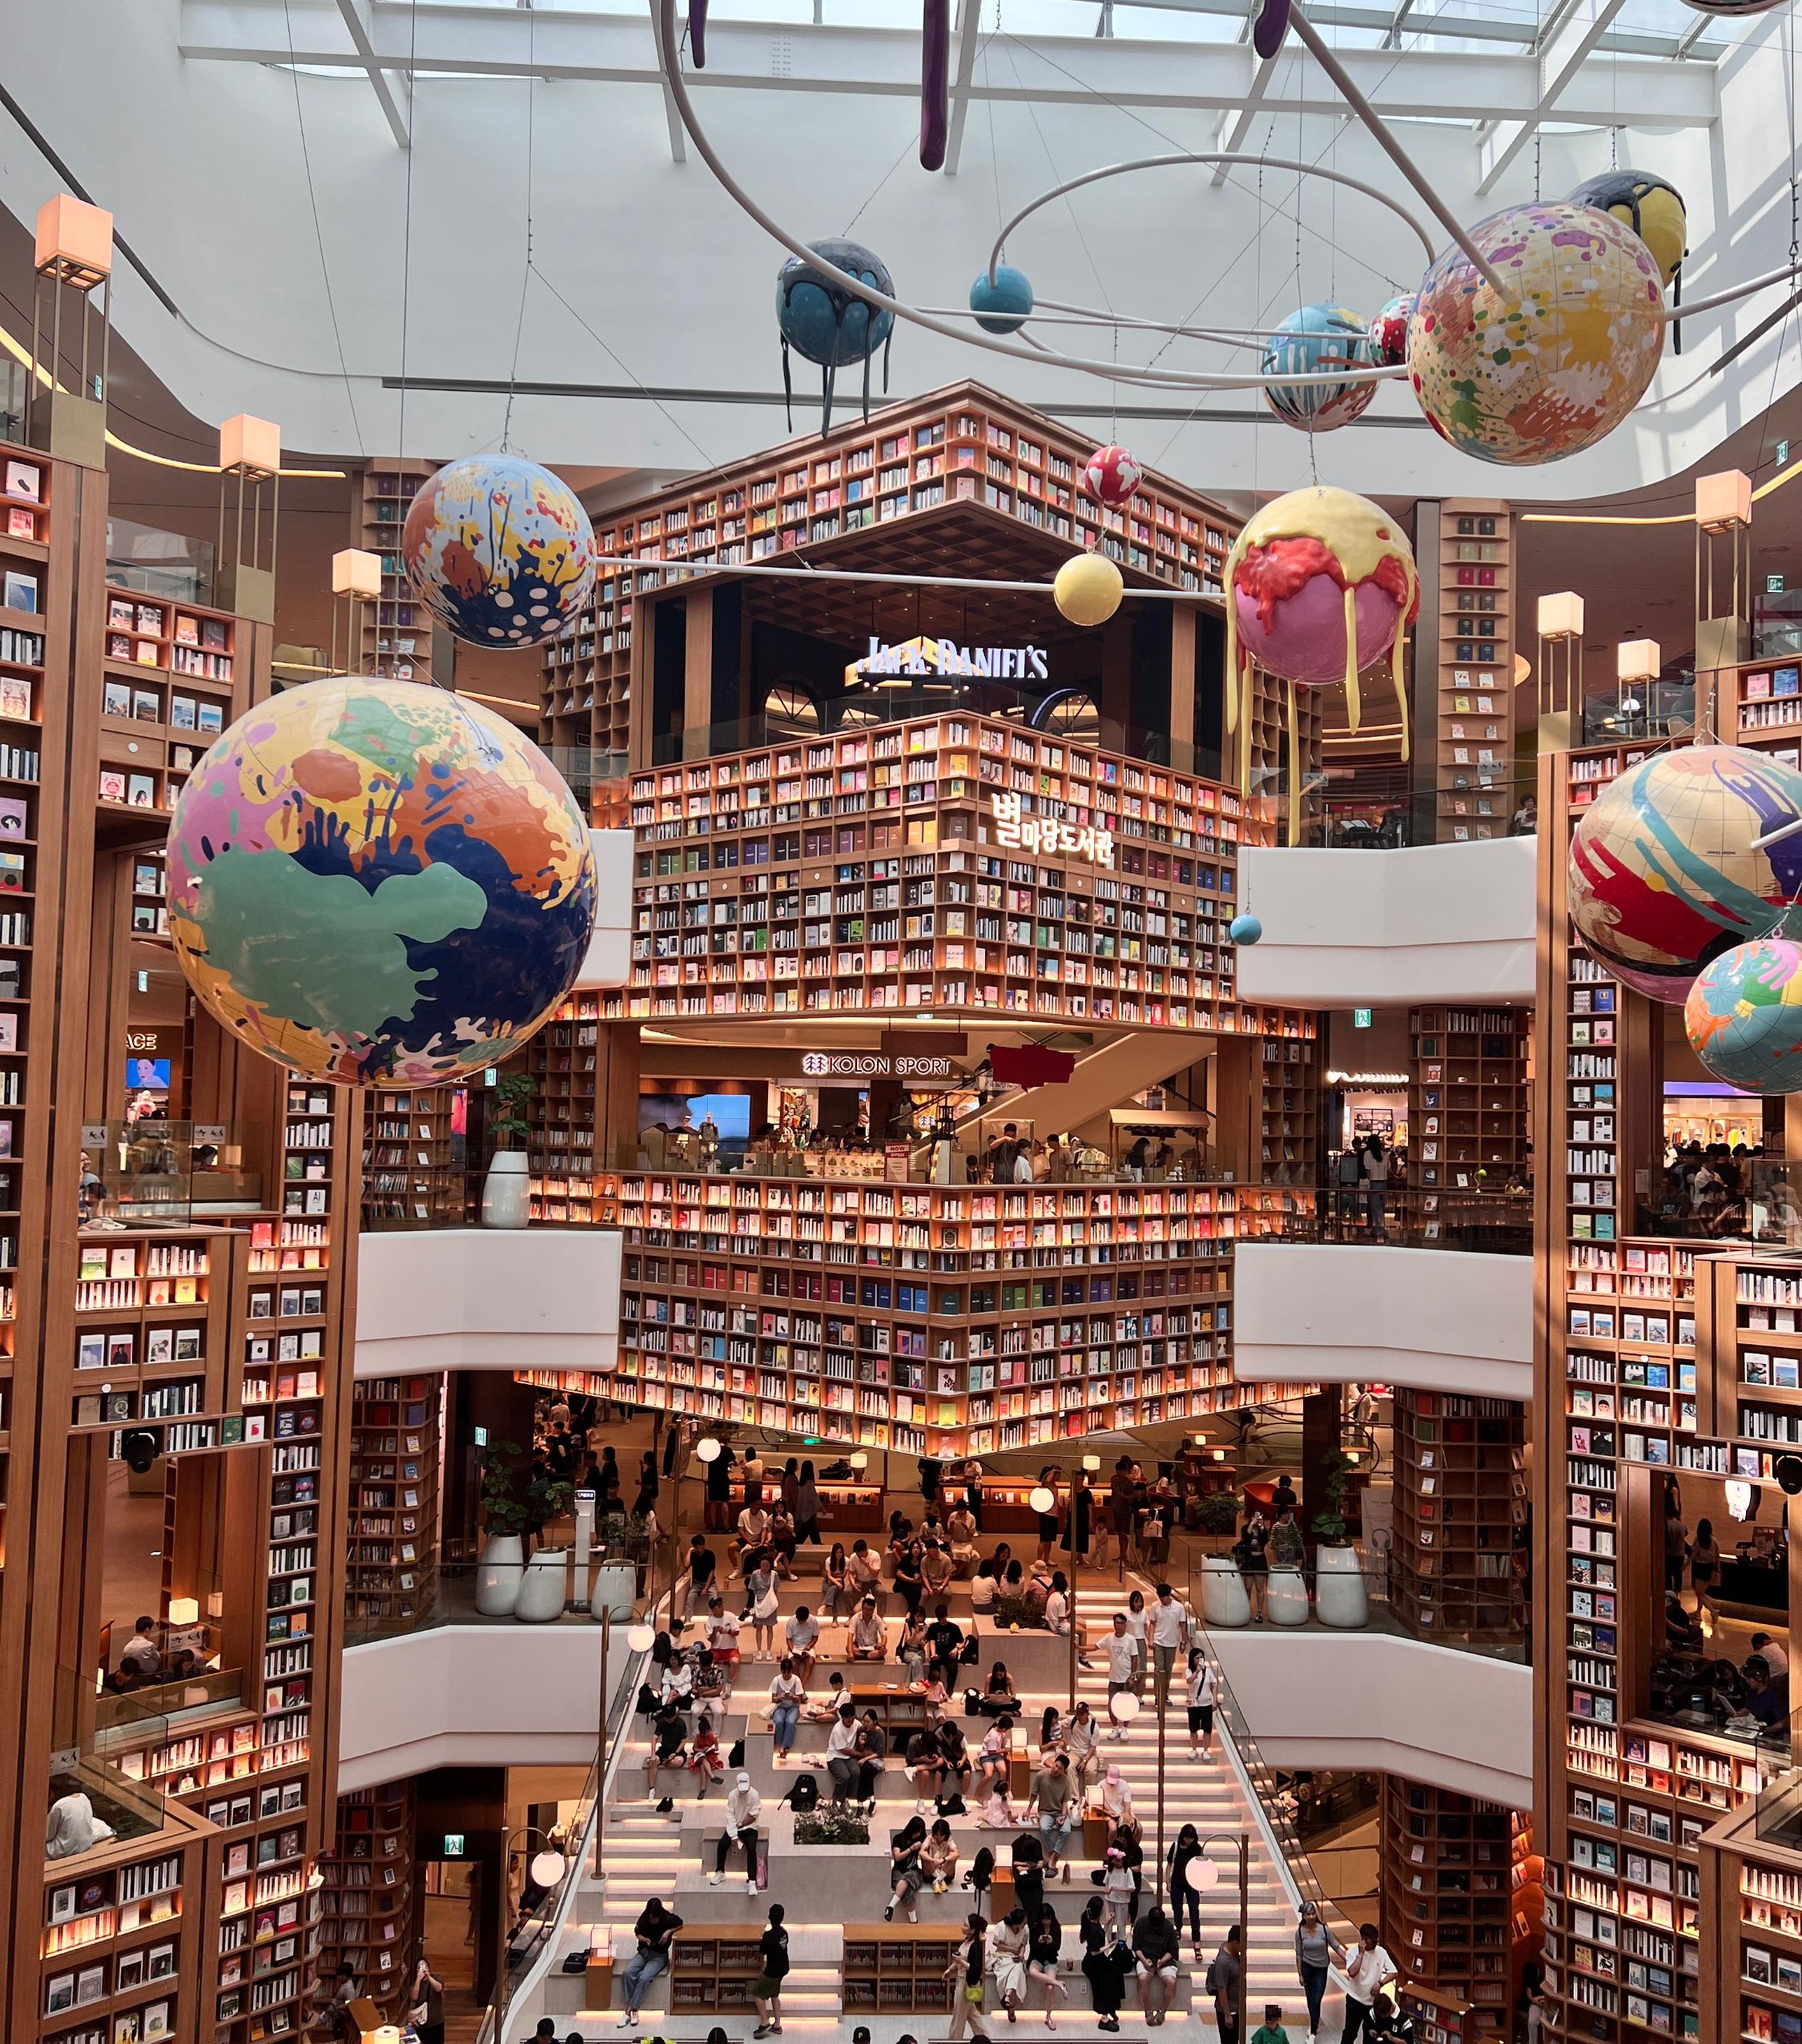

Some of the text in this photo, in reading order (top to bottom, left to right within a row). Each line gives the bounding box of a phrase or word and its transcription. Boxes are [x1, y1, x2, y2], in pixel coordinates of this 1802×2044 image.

[858, 636, 1048, 678] JACK DANIEL'S
[991, 791, 1115, 864] 별마당도서관
[829, 1056, 951, 1074] KOLON SPORT
[313, 1191, 321, 1201] AI
